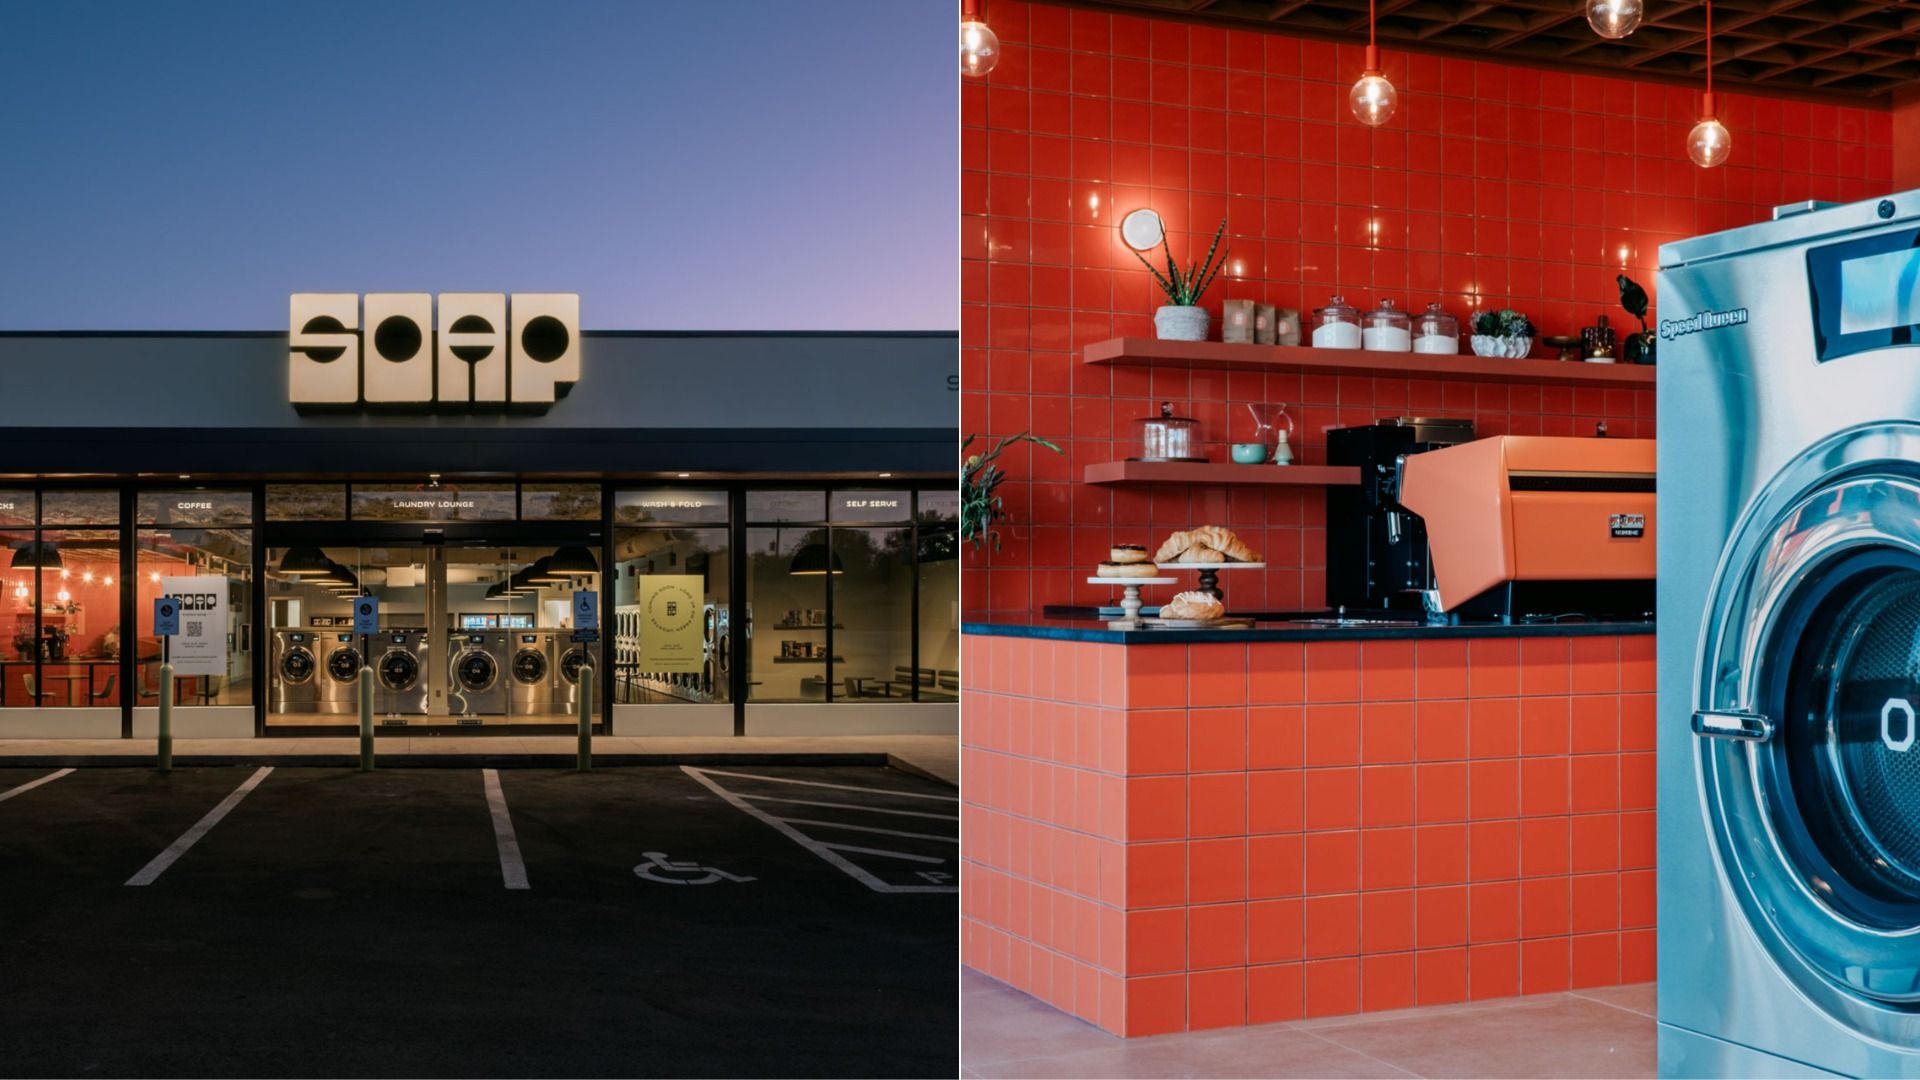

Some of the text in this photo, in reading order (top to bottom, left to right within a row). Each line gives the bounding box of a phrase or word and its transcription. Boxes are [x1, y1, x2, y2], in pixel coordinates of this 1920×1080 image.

[289, 293, 580, 405] SOAP
[1661, 308, 1748, 341] Speed Queen
